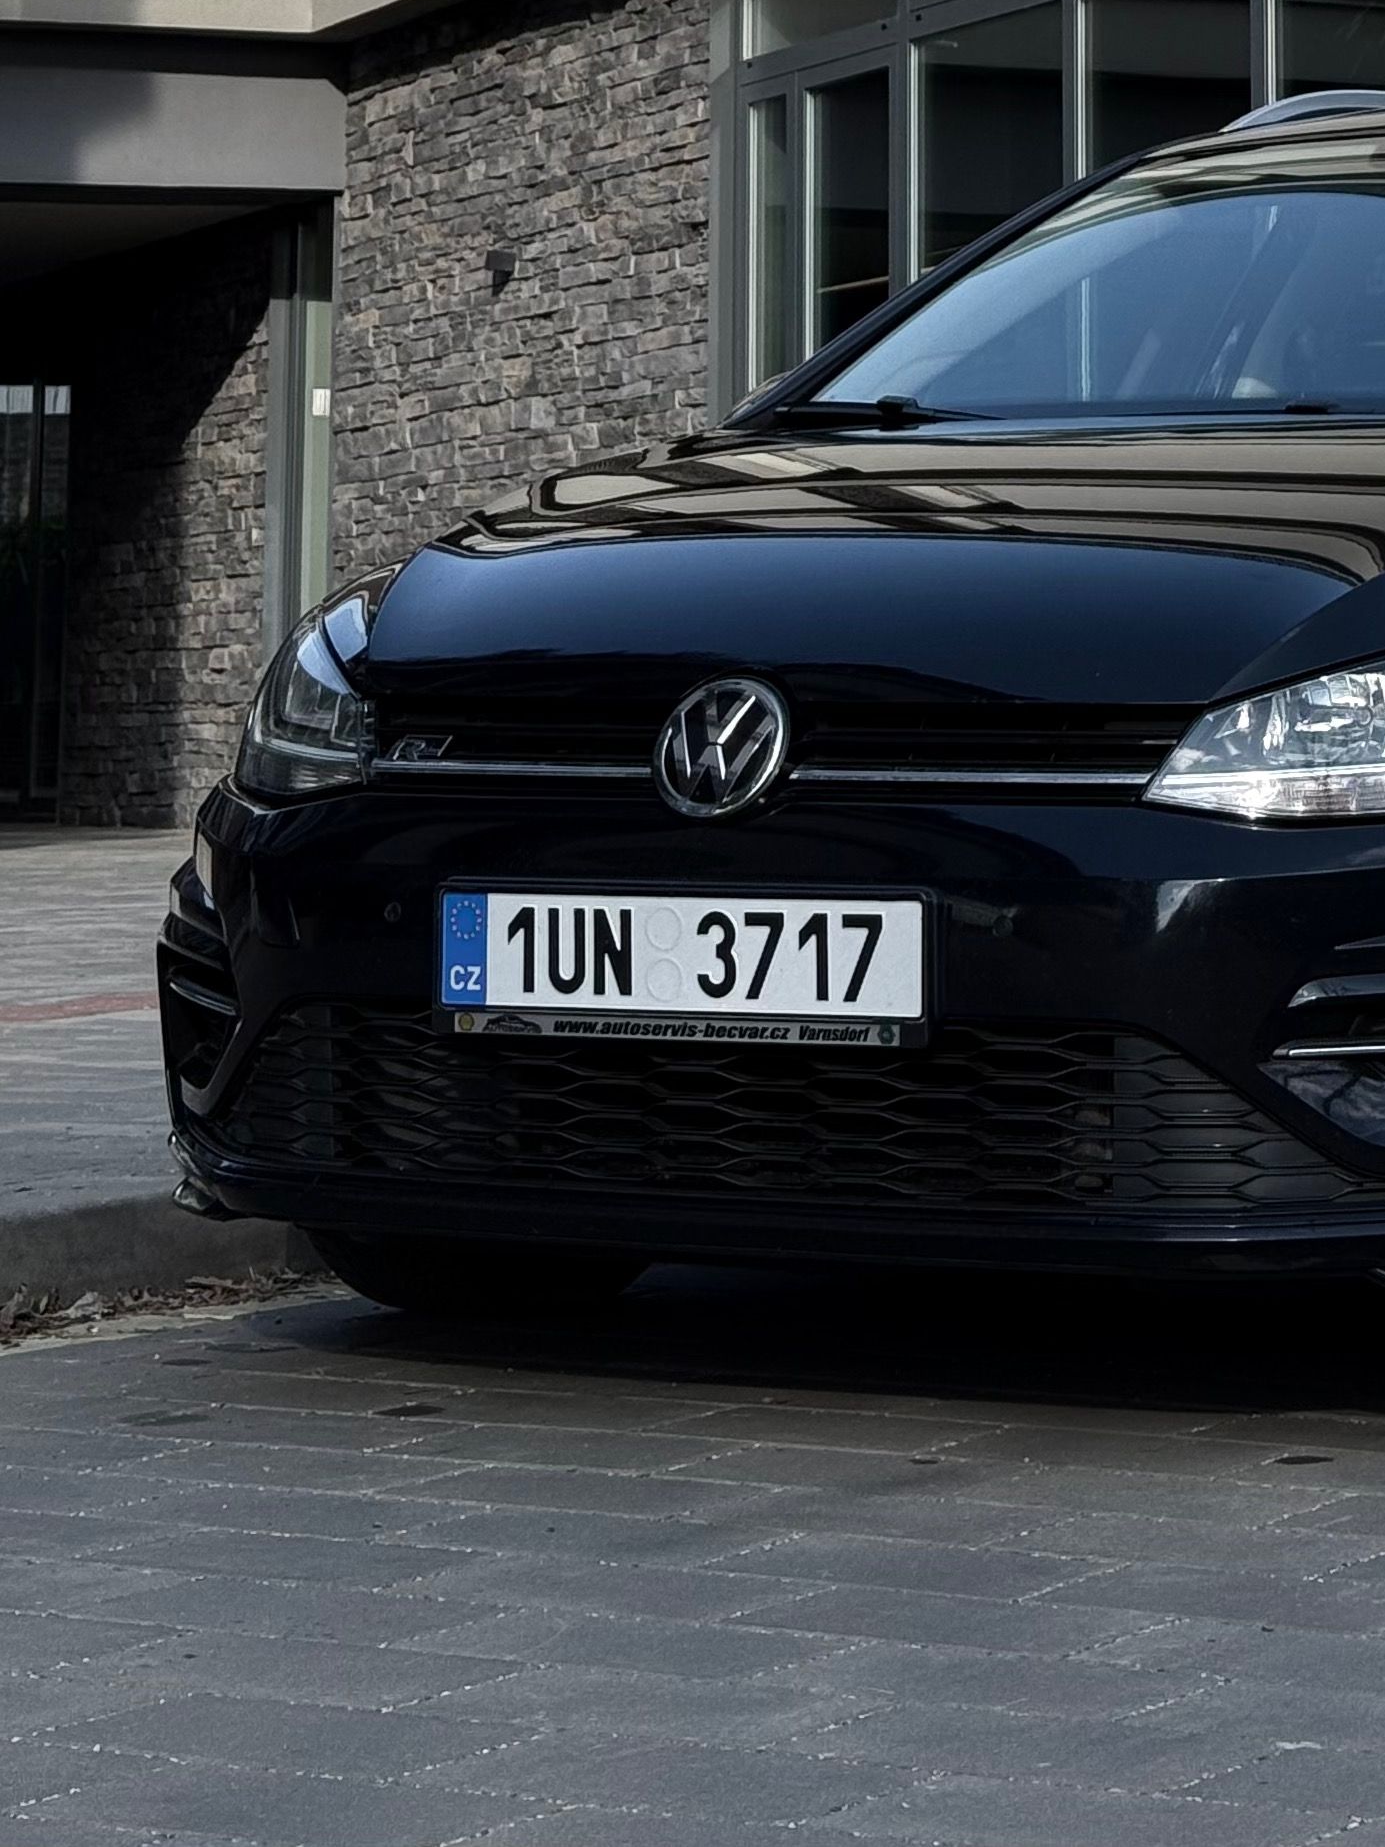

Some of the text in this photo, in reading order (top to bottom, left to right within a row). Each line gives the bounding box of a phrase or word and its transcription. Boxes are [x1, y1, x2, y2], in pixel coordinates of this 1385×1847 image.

[507, 905, 884, 1003] 1UN 3717
[448, 964, 482, 992] CZ
[552, 1020, 871, 1042] www.autoservis-becvar.cz Varnsdorf
